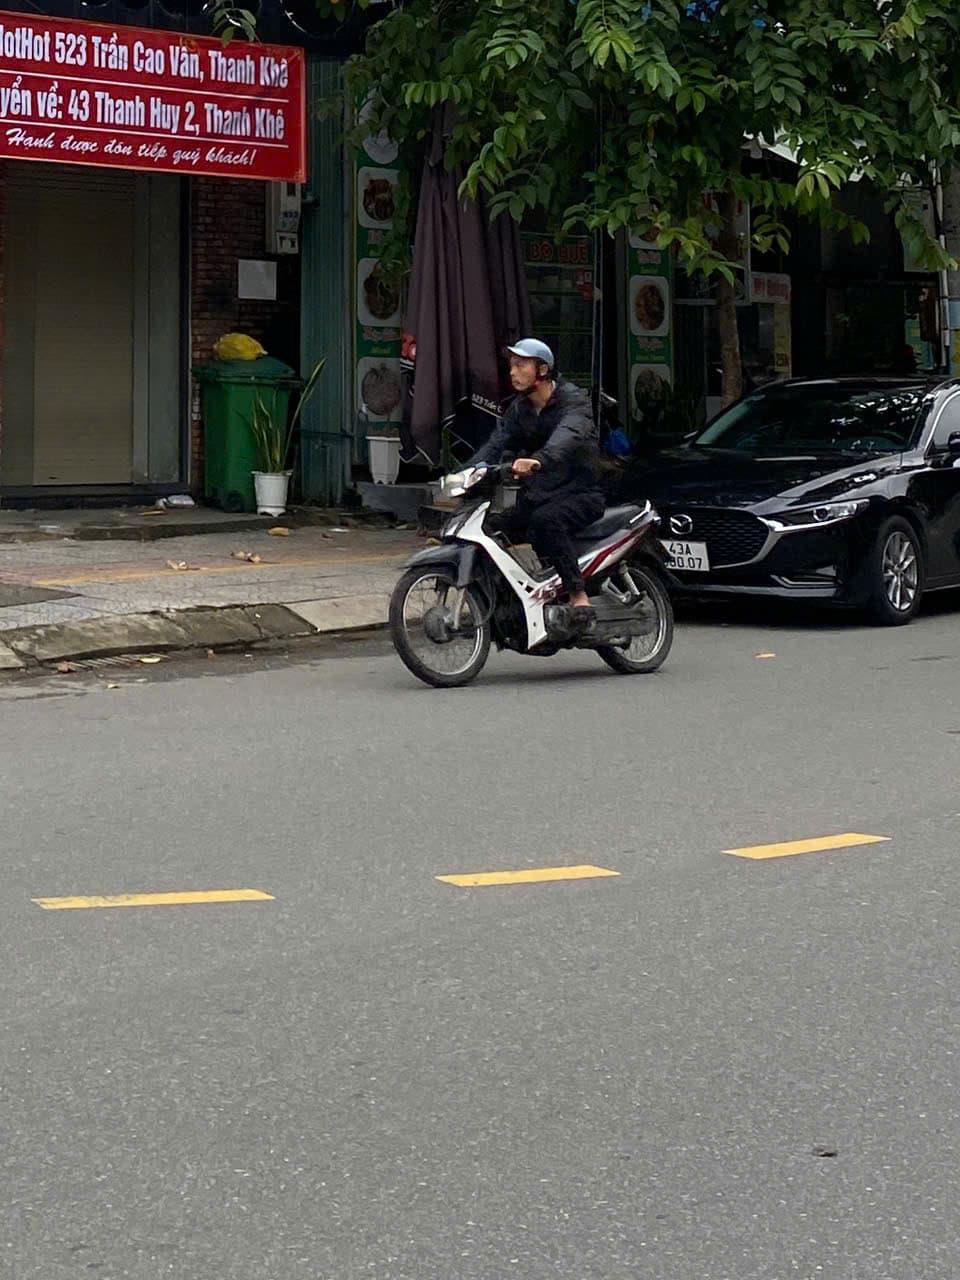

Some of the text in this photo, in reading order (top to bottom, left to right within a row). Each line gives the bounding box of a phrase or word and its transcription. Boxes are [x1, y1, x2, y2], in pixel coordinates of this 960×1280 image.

[55, 32, 87, 66] 523
[92, 32, 128, 70] Trần
[133, 40, 164, 74] Cao
[169, 45, 204, 83] Vân,
[208, 50, 255, 84] Thanh
[260, 56, 289, 88] Khê
[37, 81, 63, 119] về:
[68, 89, 89, 121] 43
[95, 91, 145, 126] Thanh
[150, 97, 180, 133] Huy
[185, 101, 200, 135] 2,
[204, 102, 251, 136] Thanh
[255, 107, 285, 140] Khê
[6, 127, 55, 150] Hạnh
[61, 135, 98, 154] được
[137, 141, 167, 162] tiếp
[173, 150, 201, 165] quý
[205, 146, 256, 165] khách!
[669, 543, 692, 555] 43A
